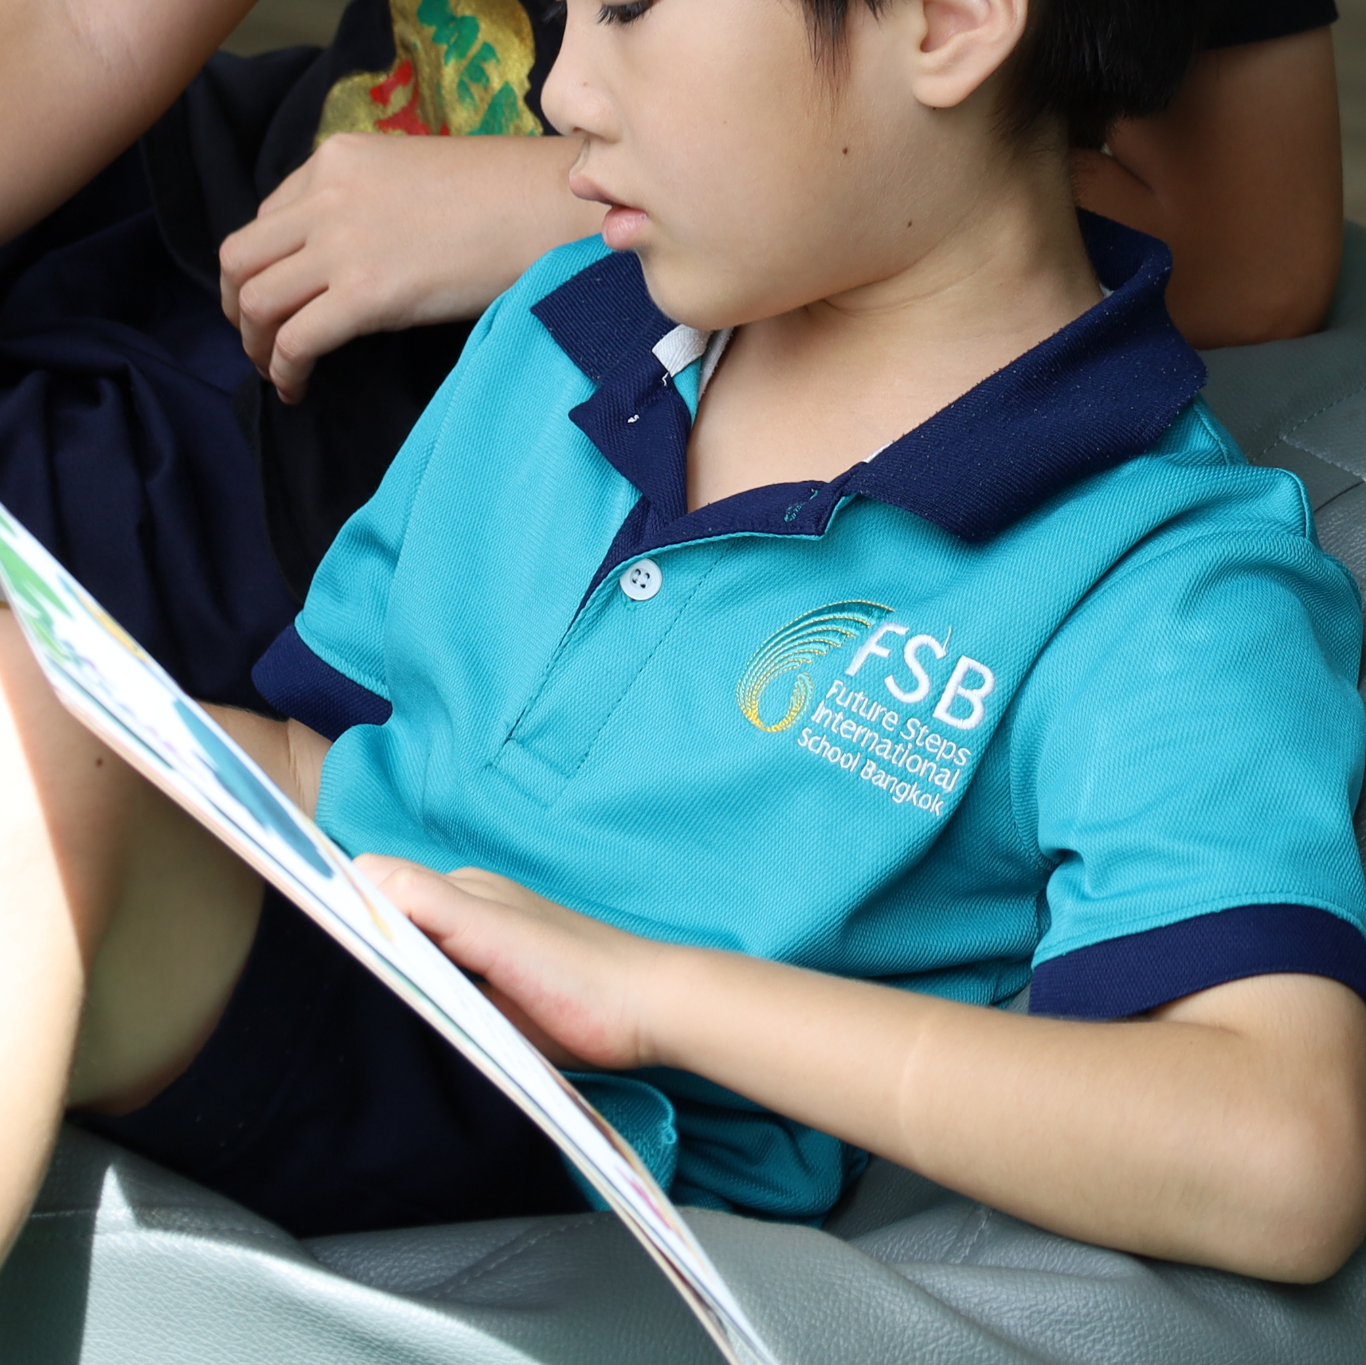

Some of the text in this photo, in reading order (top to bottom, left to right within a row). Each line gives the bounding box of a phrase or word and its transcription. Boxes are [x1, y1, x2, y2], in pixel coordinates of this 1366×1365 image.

[844, 622, 996, 730] FSB
[811, 700, 961, 793] International
[826, 679, 971, 766] Future Steps
[797, 727, 944, 816] School Bangkok
